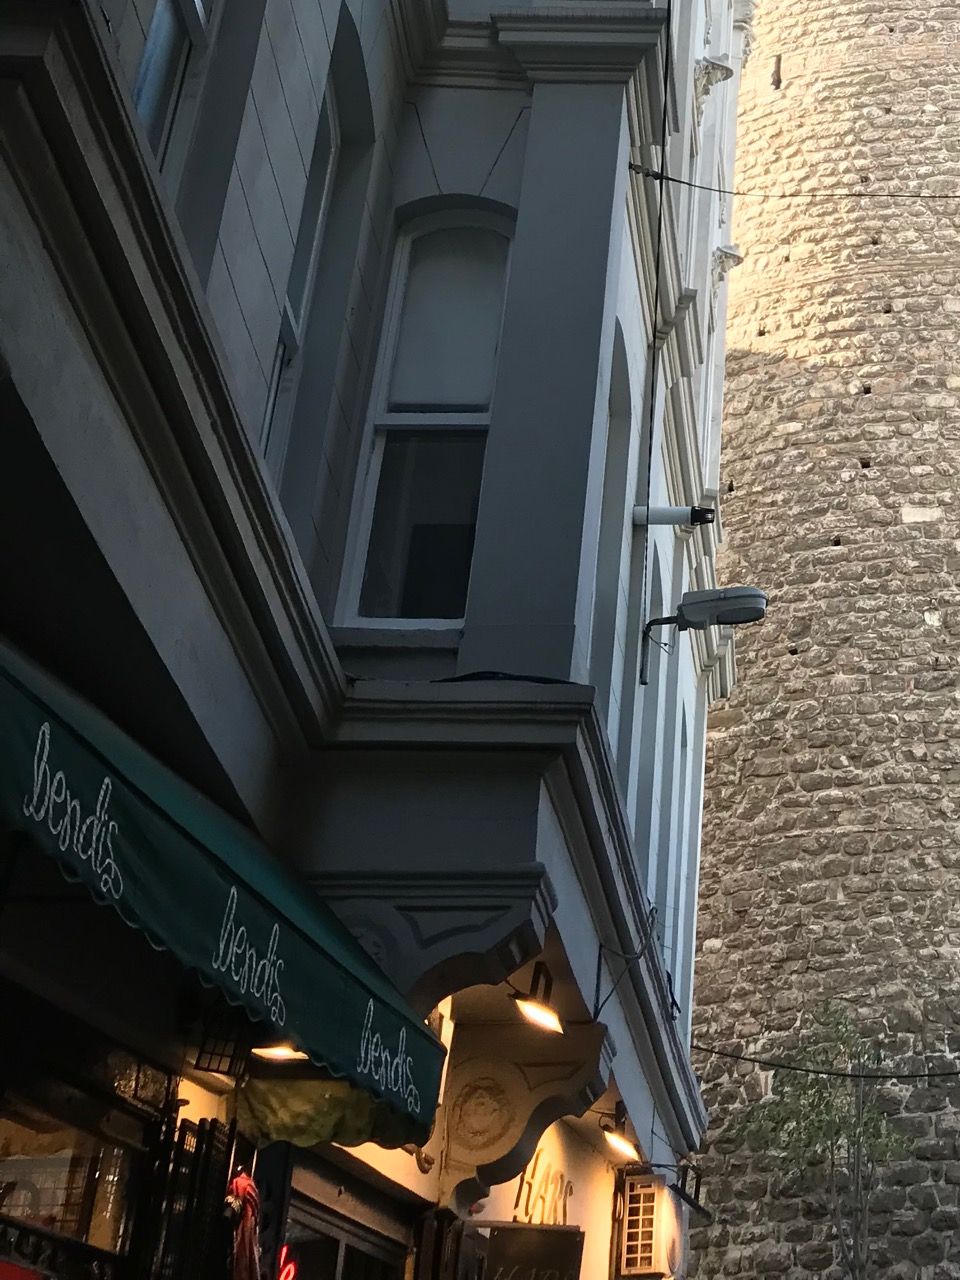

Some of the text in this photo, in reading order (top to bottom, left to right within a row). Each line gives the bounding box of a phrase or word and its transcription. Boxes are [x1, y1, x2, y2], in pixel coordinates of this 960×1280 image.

[22, 721, 124, 900] bendis
[212, 885, 286, 1027] bendis
[356, 998, 421, 1113] bendis
